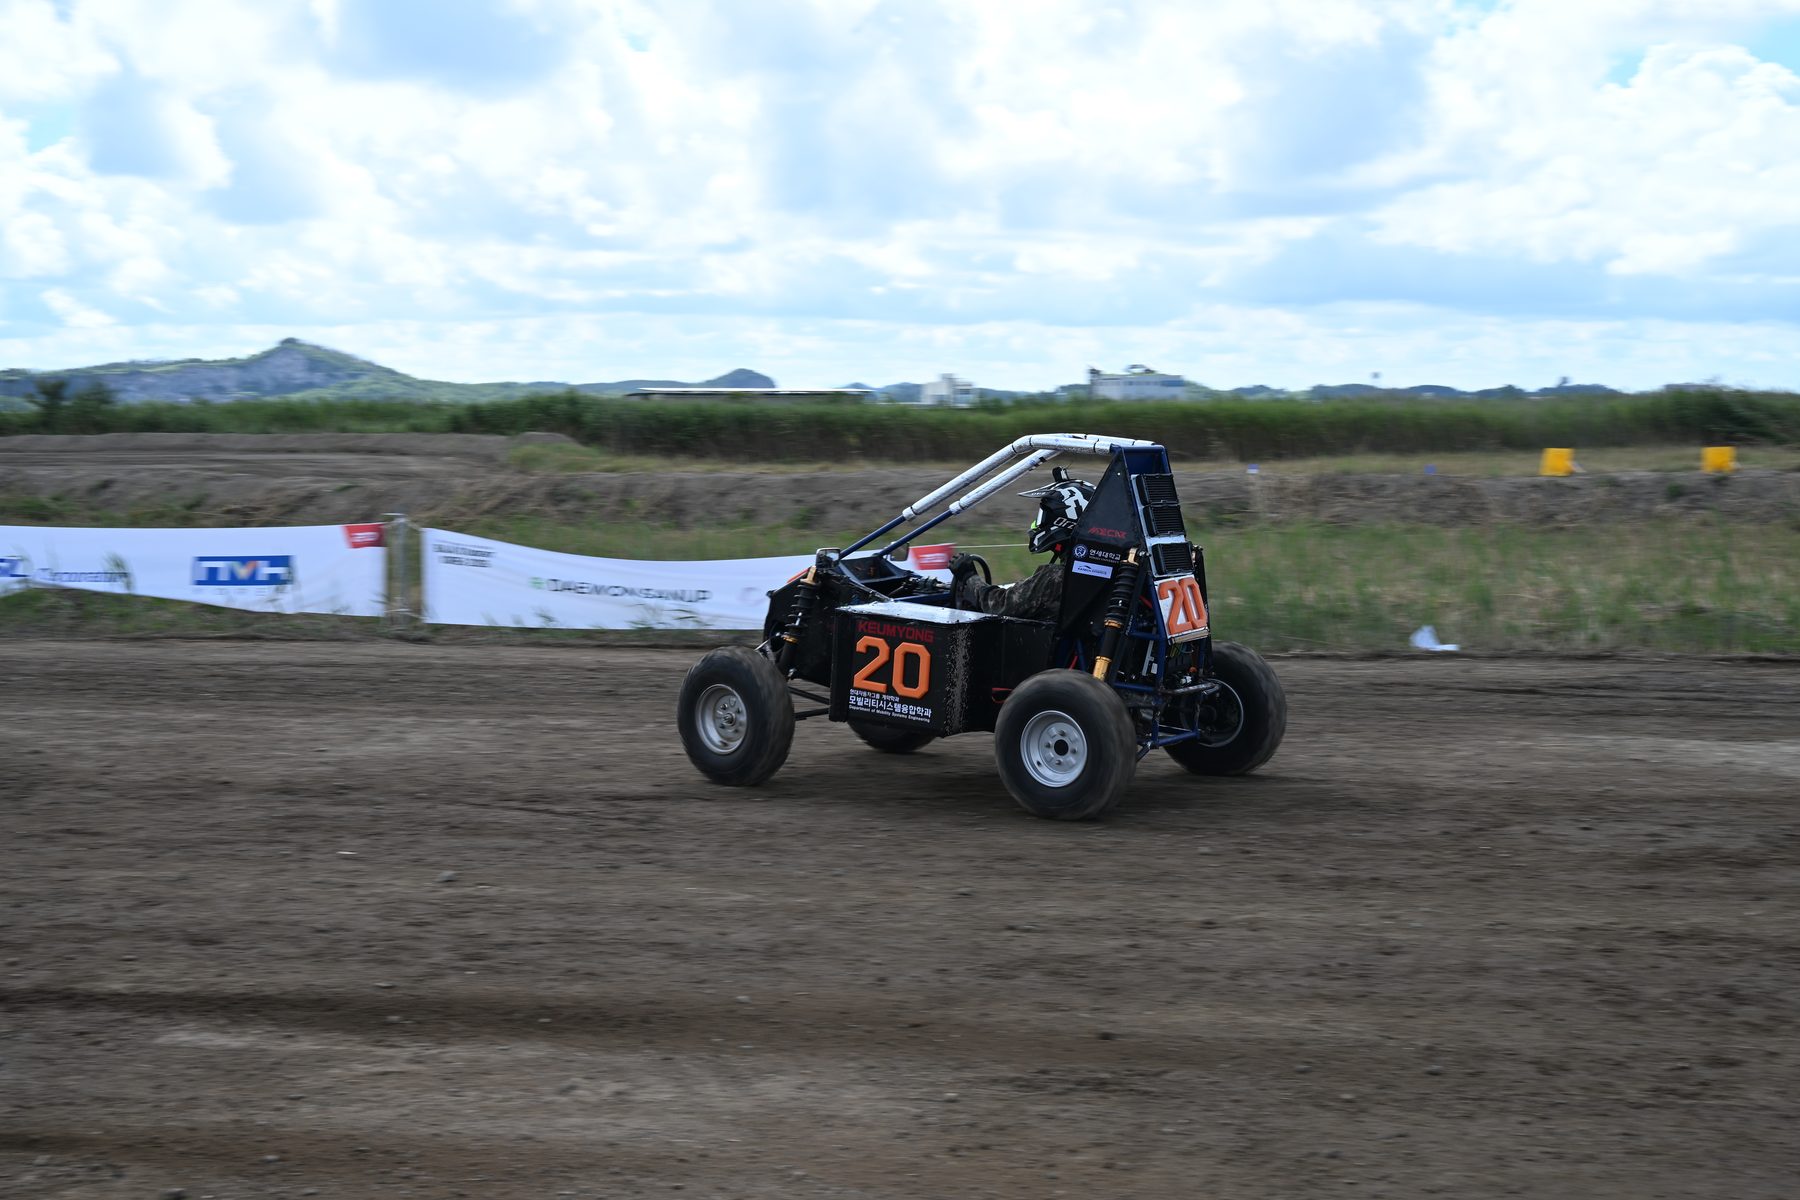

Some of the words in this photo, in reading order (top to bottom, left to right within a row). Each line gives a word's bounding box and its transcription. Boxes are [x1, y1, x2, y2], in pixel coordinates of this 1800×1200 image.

[1089, 548, 1121, 561] 연세대학교
[1158, 577, 1208, 635] 20
[856, 620, 936, 642] KEUMYONG
[853, 635, 931, 699] 20
[849, 695, 932, 718] 모빌리티시스템융합학과
[849, 705, 870, 713] Department
[908, 715, 930, 723] Engineering
